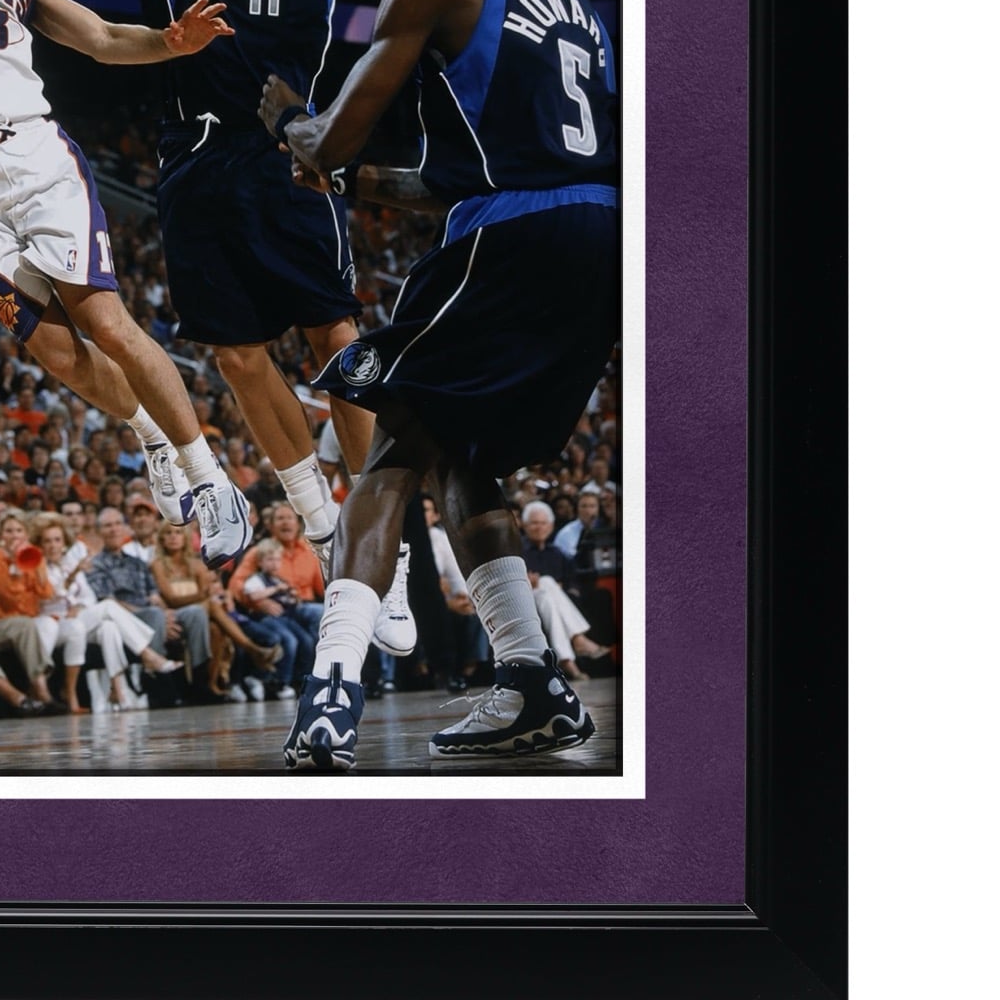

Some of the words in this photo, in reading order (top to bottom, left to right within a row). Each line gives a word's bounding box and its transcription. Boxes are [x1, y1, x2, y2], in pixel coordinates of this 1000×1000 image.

[557, 38, 598, 157] 5
[330, 166, 346, 195] 5
[95, 230, 116, 274] 1
